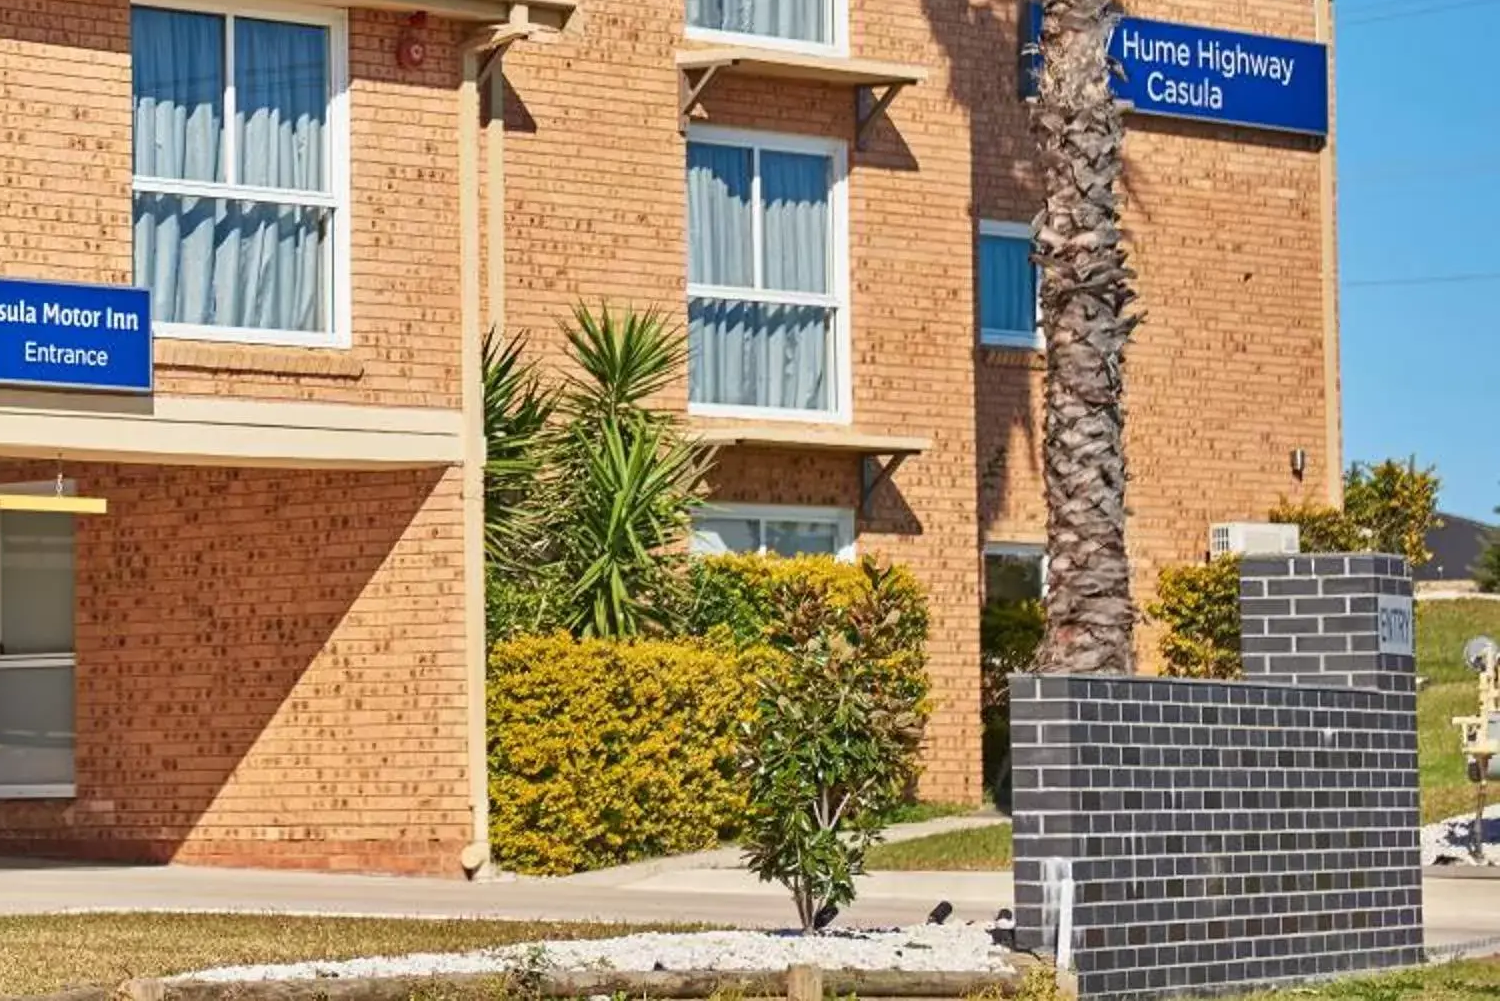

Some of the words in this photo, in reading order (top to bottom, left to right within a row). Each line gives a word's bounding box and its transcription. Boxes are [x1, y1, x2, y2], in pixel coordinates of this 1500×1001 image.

[1123, 29, 1190, 66] Hume
[1198, 39, 1294, 85] Highway
[1147, 72, 1223, 109] Casula
[42, 302, 102, 328] Motor
[106, 307, 139, 331] Inn
[24, 340, 109, 366] Entrance
